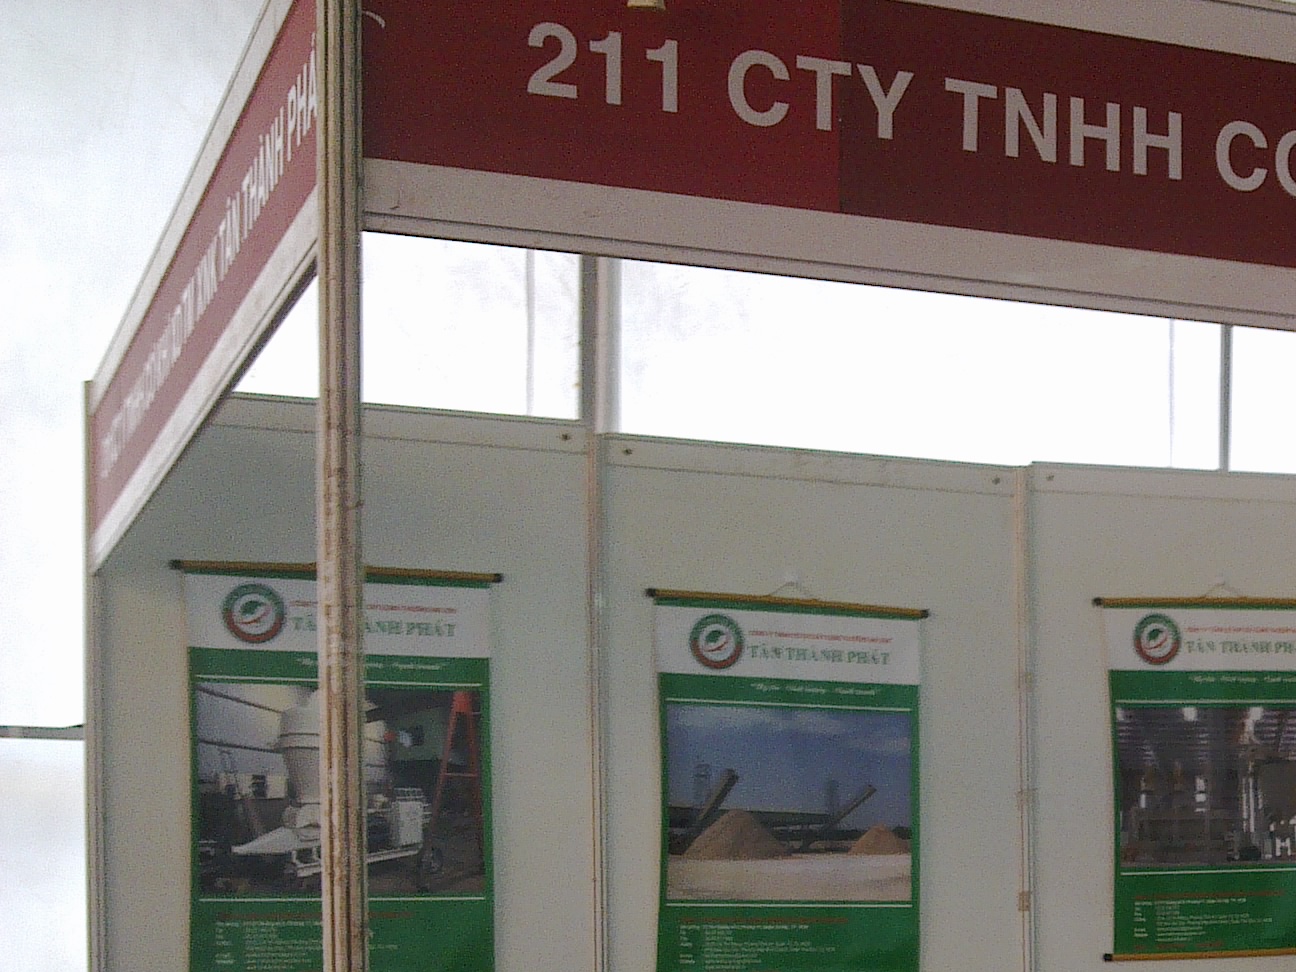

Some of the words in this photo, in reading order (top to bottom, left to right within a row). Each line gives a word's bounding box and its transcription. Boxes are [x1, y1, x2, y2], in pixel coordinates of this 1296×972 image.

[218, 193, 241, 284] TÂN
[241, 105, 285, 242] THÀNH
[286, 34, 318, 163] PHÁ
[526, 21, 681, 113] 211
[726, 49, 914, 141] CTY
[945, 77, 1183, 181] TNHH
